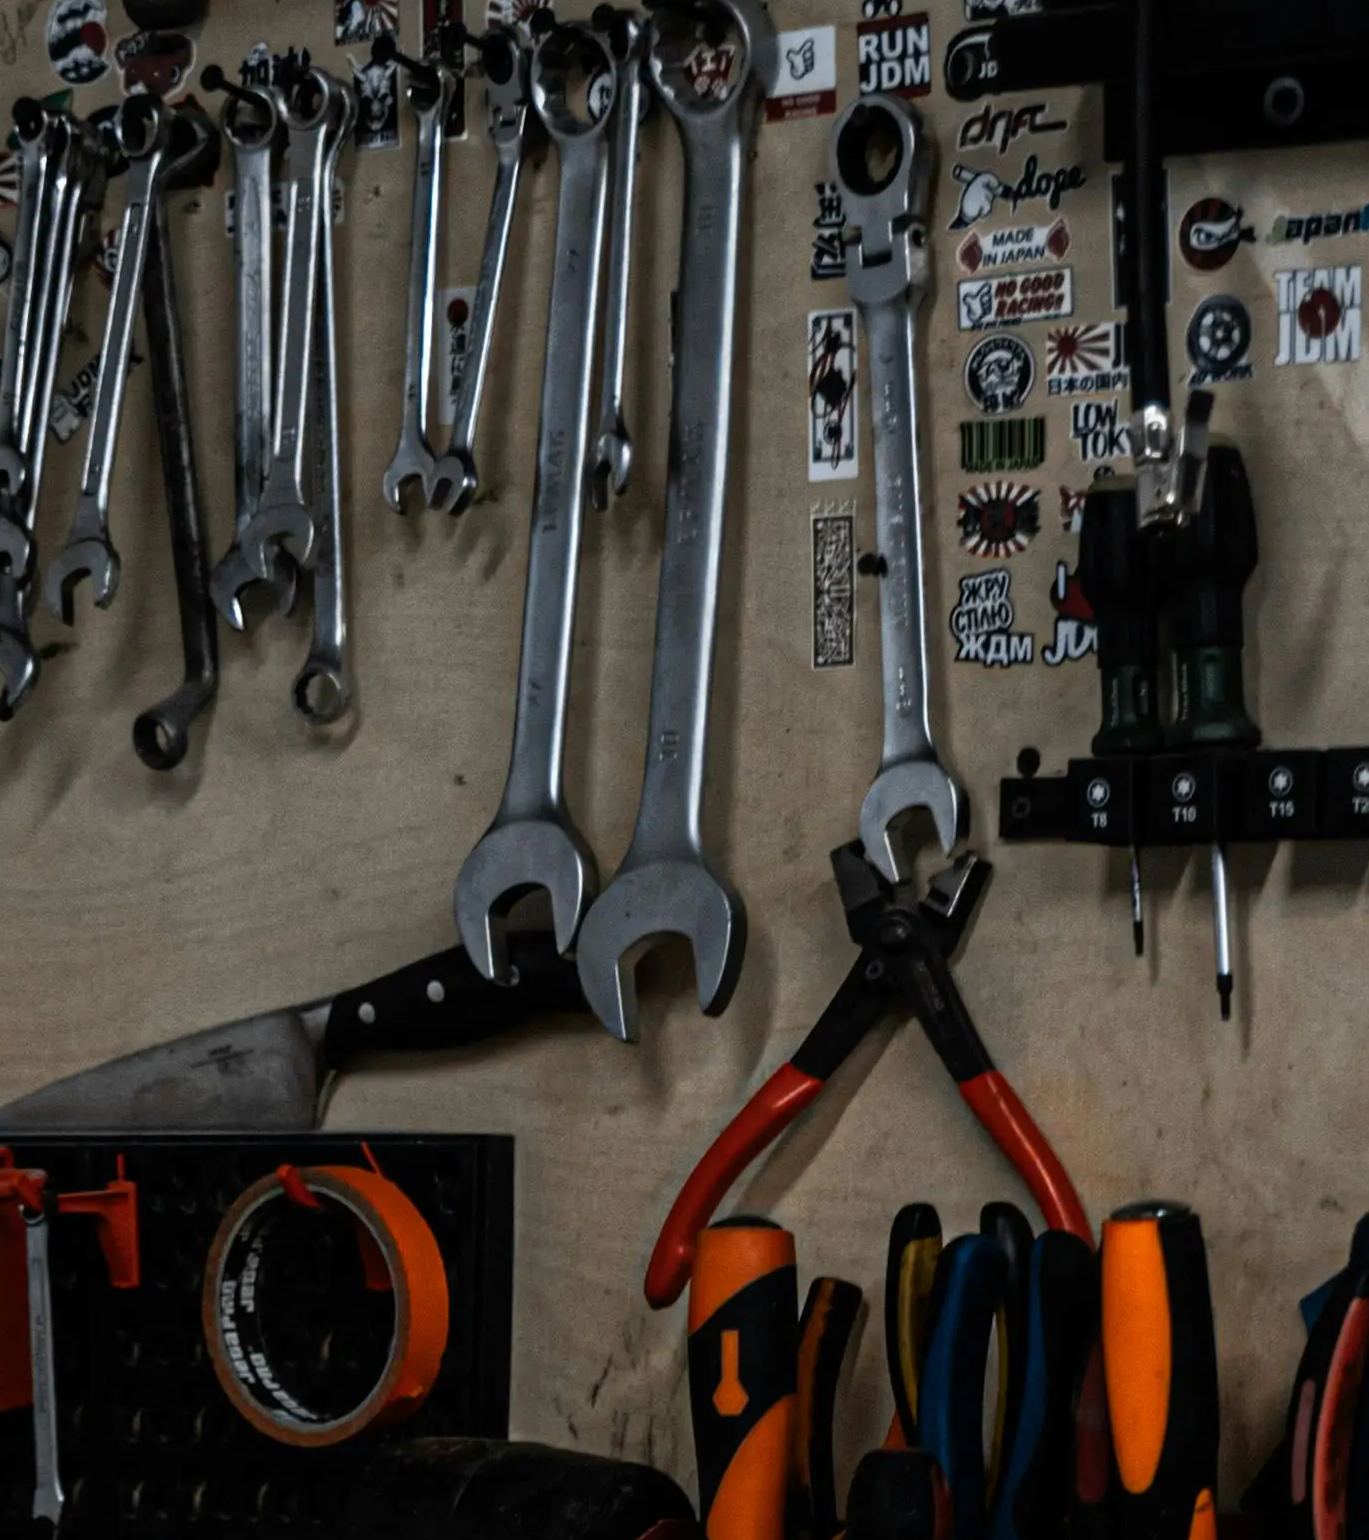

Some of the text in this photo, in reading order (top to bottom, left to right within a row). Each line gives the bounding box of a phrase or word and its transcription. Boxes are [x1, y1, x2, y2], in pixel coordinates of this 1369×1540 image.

[859, 24, 929, 64] RUN
[861, 60, 930, 95] JDM
[978, 60, 1000, 79] JD
[1011, 154, 1088, 212] dope
[992, 228, 1034, 247] MADE
[983, 245, 1045, 267] IN JAPAN
[995, 272, 1065, 299] NO GOOD
[1072, 396, 1120, 437] LOW
[963, 574, 1008, 605] ЖРУ
[954, 601, 1010, 633] СПЛЮ
[957, 633, 1032, 667] ЖДМ
[1090, 811, 1109, 829] T8
[1171, 805, 1197, 824] T10
[1268, 799, 1296, 819] T15
